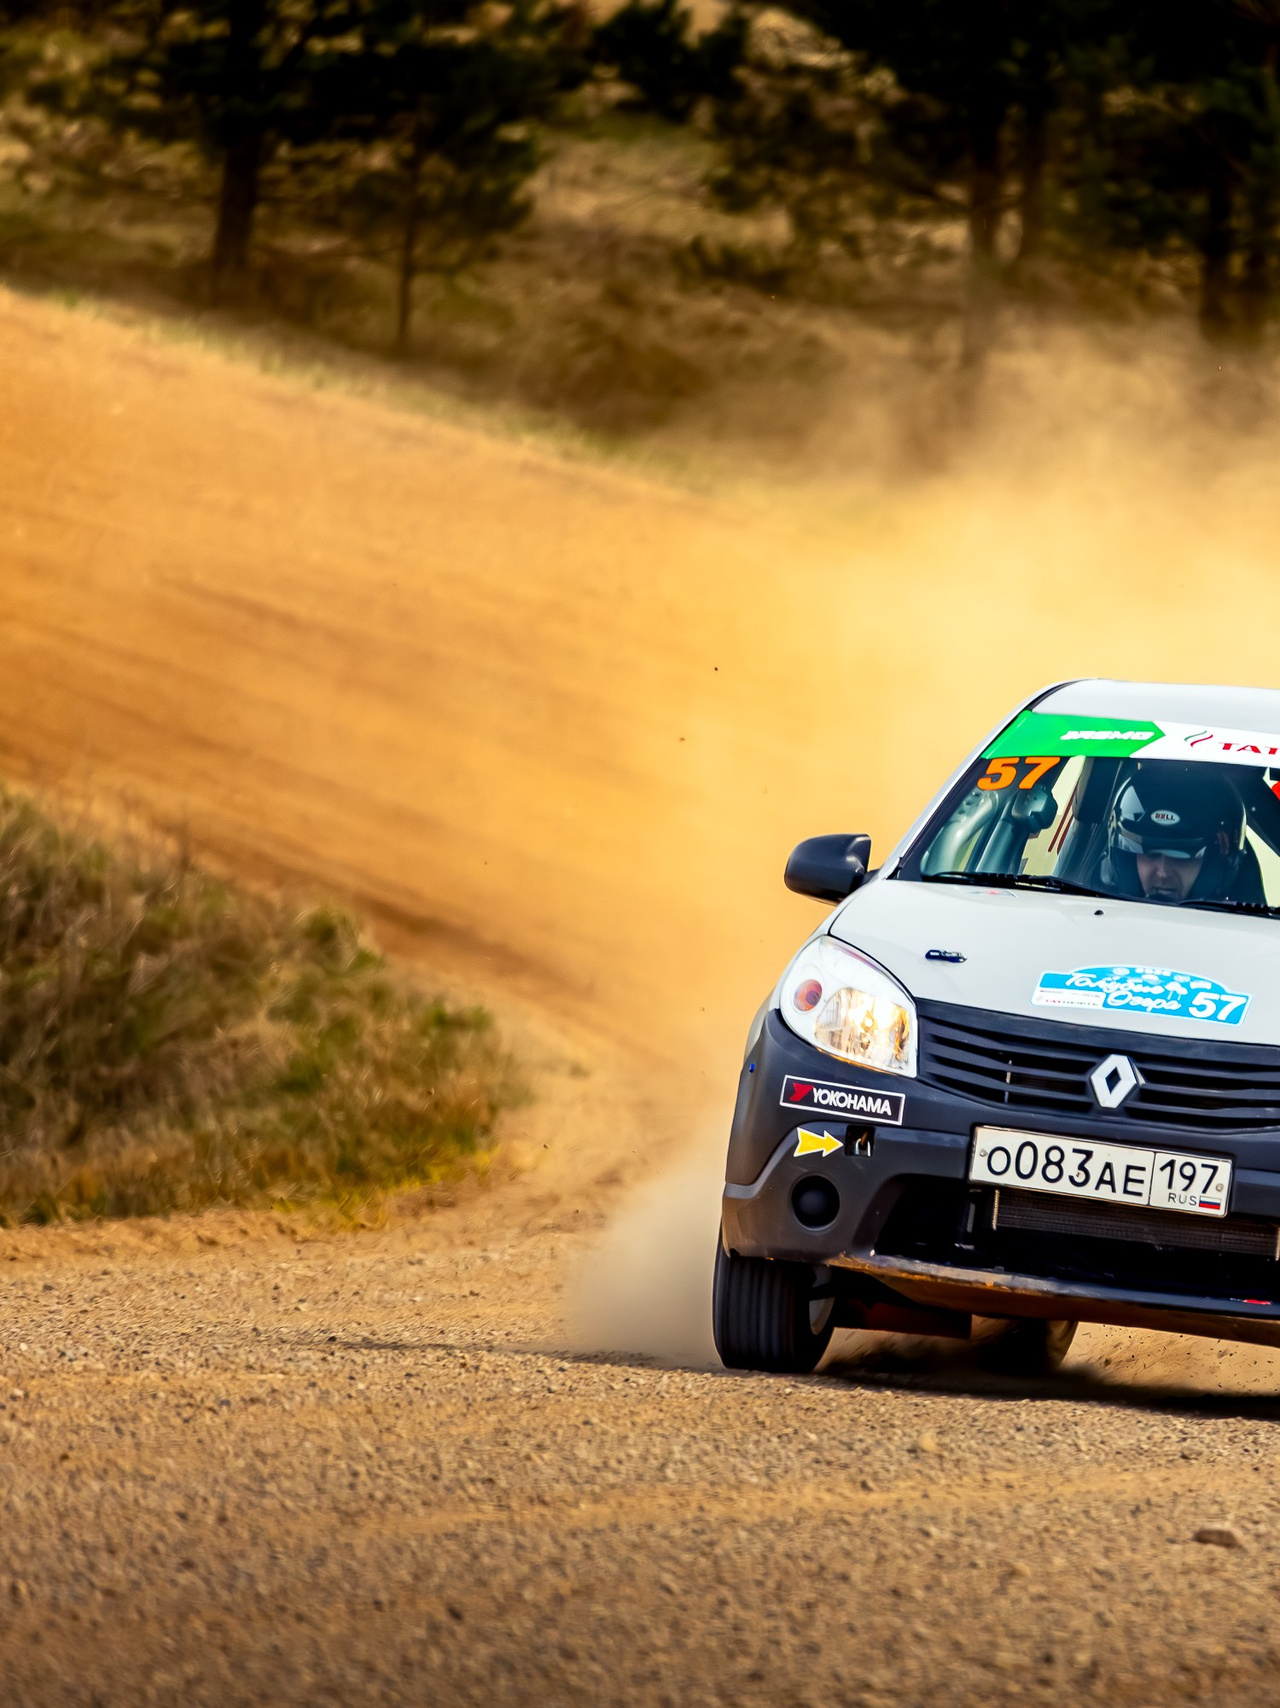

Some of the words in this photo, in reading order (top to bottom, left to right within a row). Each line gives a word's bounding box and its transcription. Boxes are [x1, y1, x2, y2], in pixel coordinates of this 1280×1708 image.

[977, 757, 1061, 790] 57
[1188, 991, 1247, 1021] 57
[813, 1087, 892, 1116] YOKOHAMA
[1159, 1158, 1219, 1194] 197
[1168, 1192, 1197, 1206] RUS
